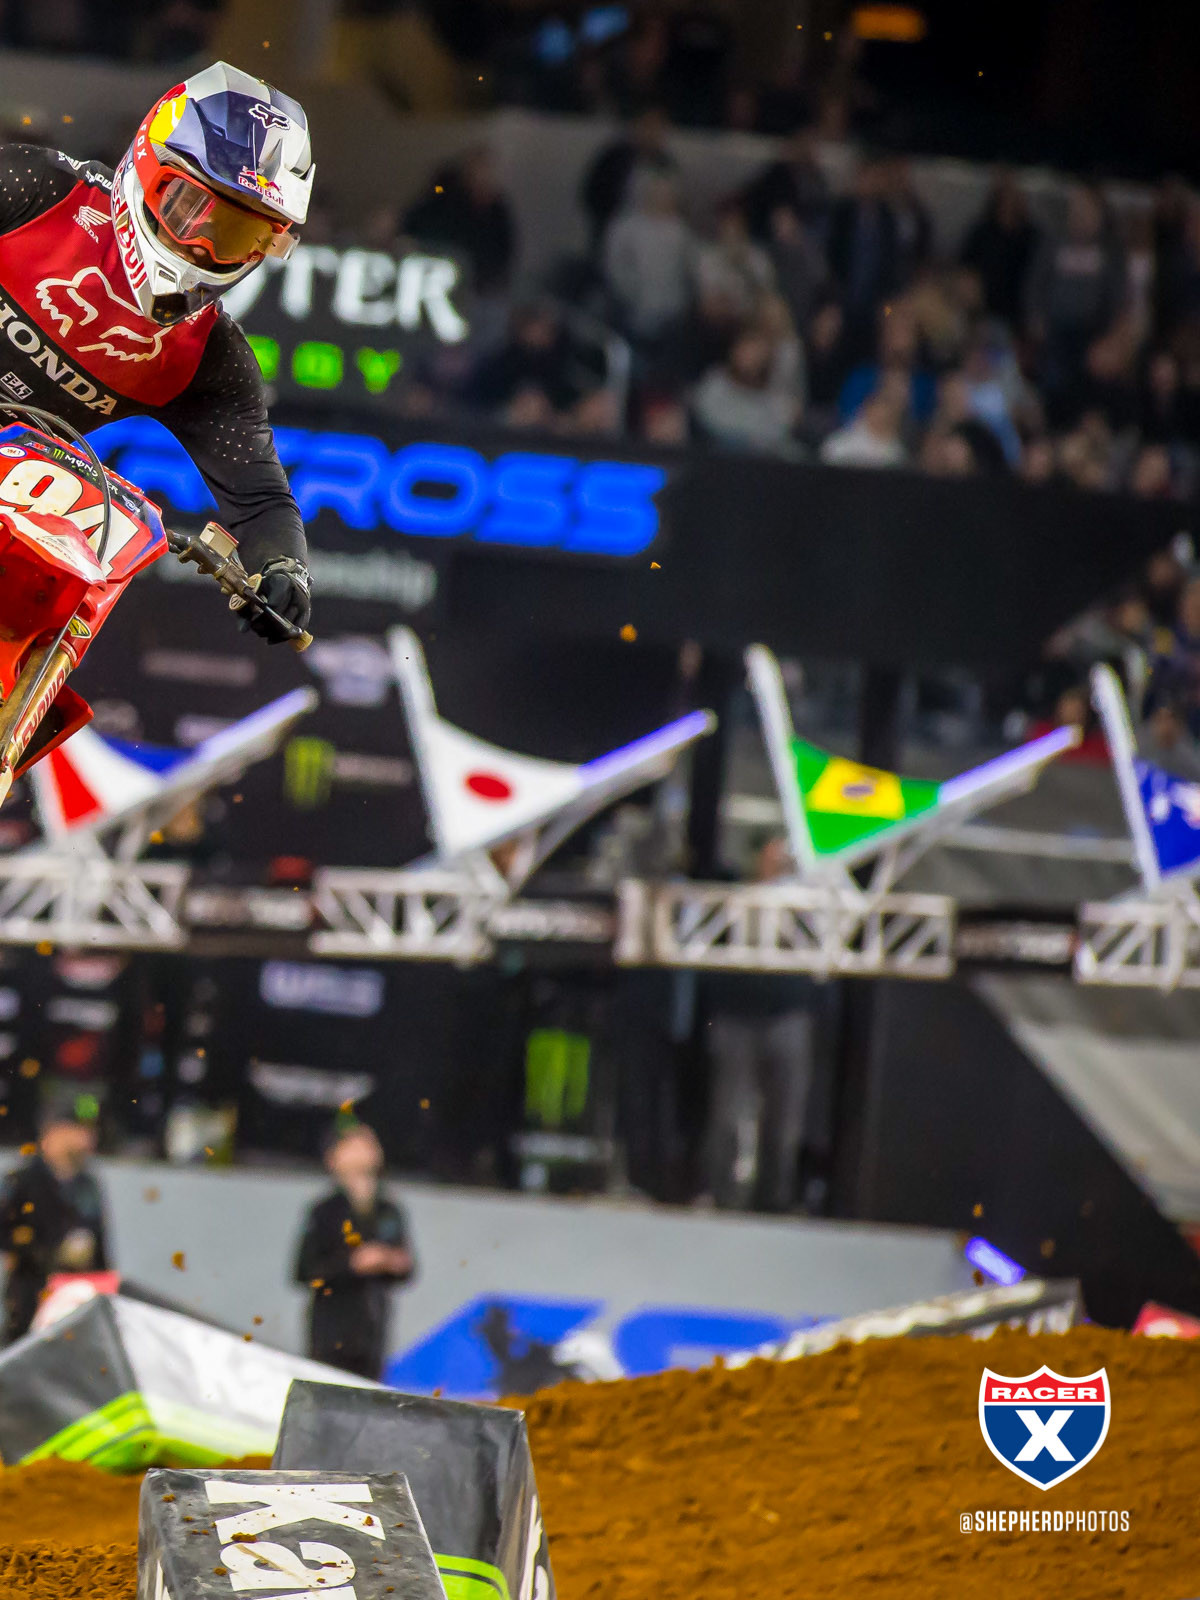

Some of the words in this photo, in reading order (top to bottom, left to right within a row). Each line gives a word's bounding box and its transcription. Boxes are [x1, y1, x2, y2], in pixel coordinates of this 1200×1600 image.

[136, 124, 148, 160] FOX
[238, 176, 264, 196] Red
[264, 189, 284, 206] Bull
[72, 213, 100, 244] HONDA
[116, 213, 148, 290] Bull
[204, 1481, 386, 1600] Ka
